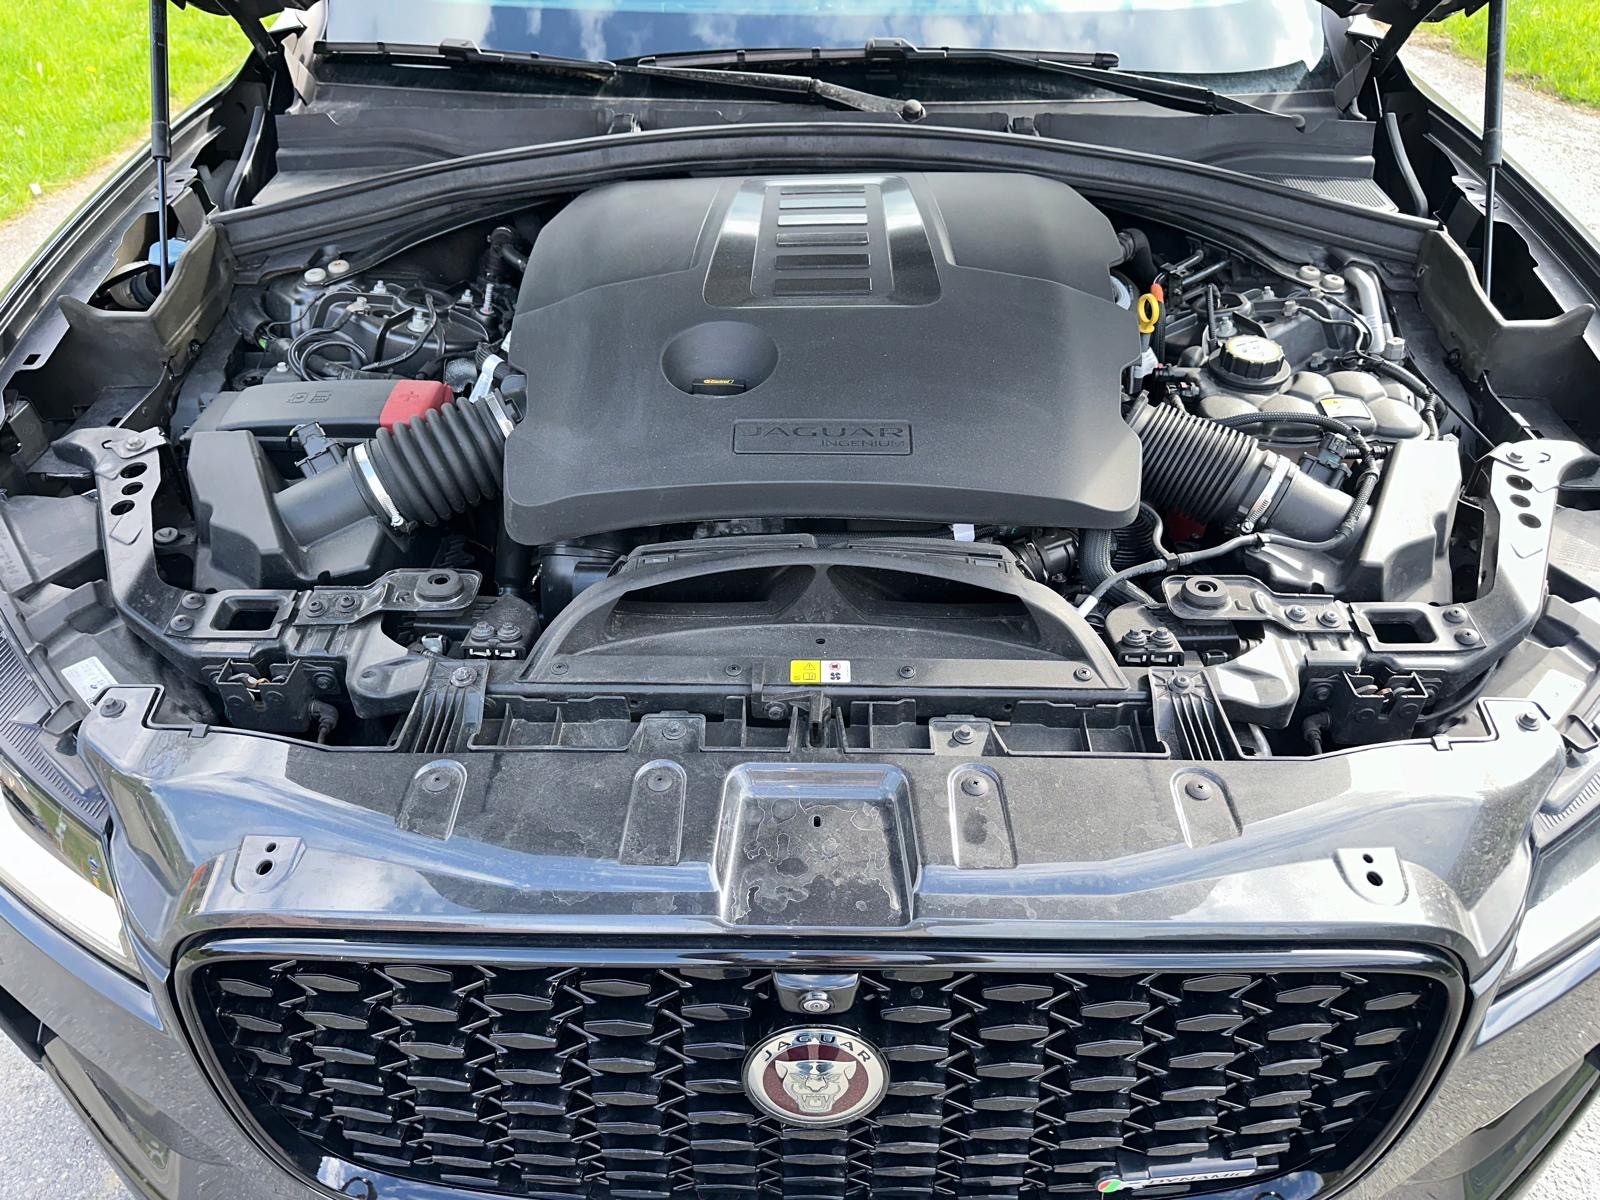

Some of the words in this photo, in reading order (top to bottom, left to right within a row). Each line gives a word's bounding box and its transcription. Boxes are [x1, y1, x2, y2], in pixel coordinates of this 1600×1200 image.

[743, 426, 904, 437] JAGUAR
[821, 439, 905, 447] INGENIUM
[765, 1034, 871, 1062] JAGUAR
